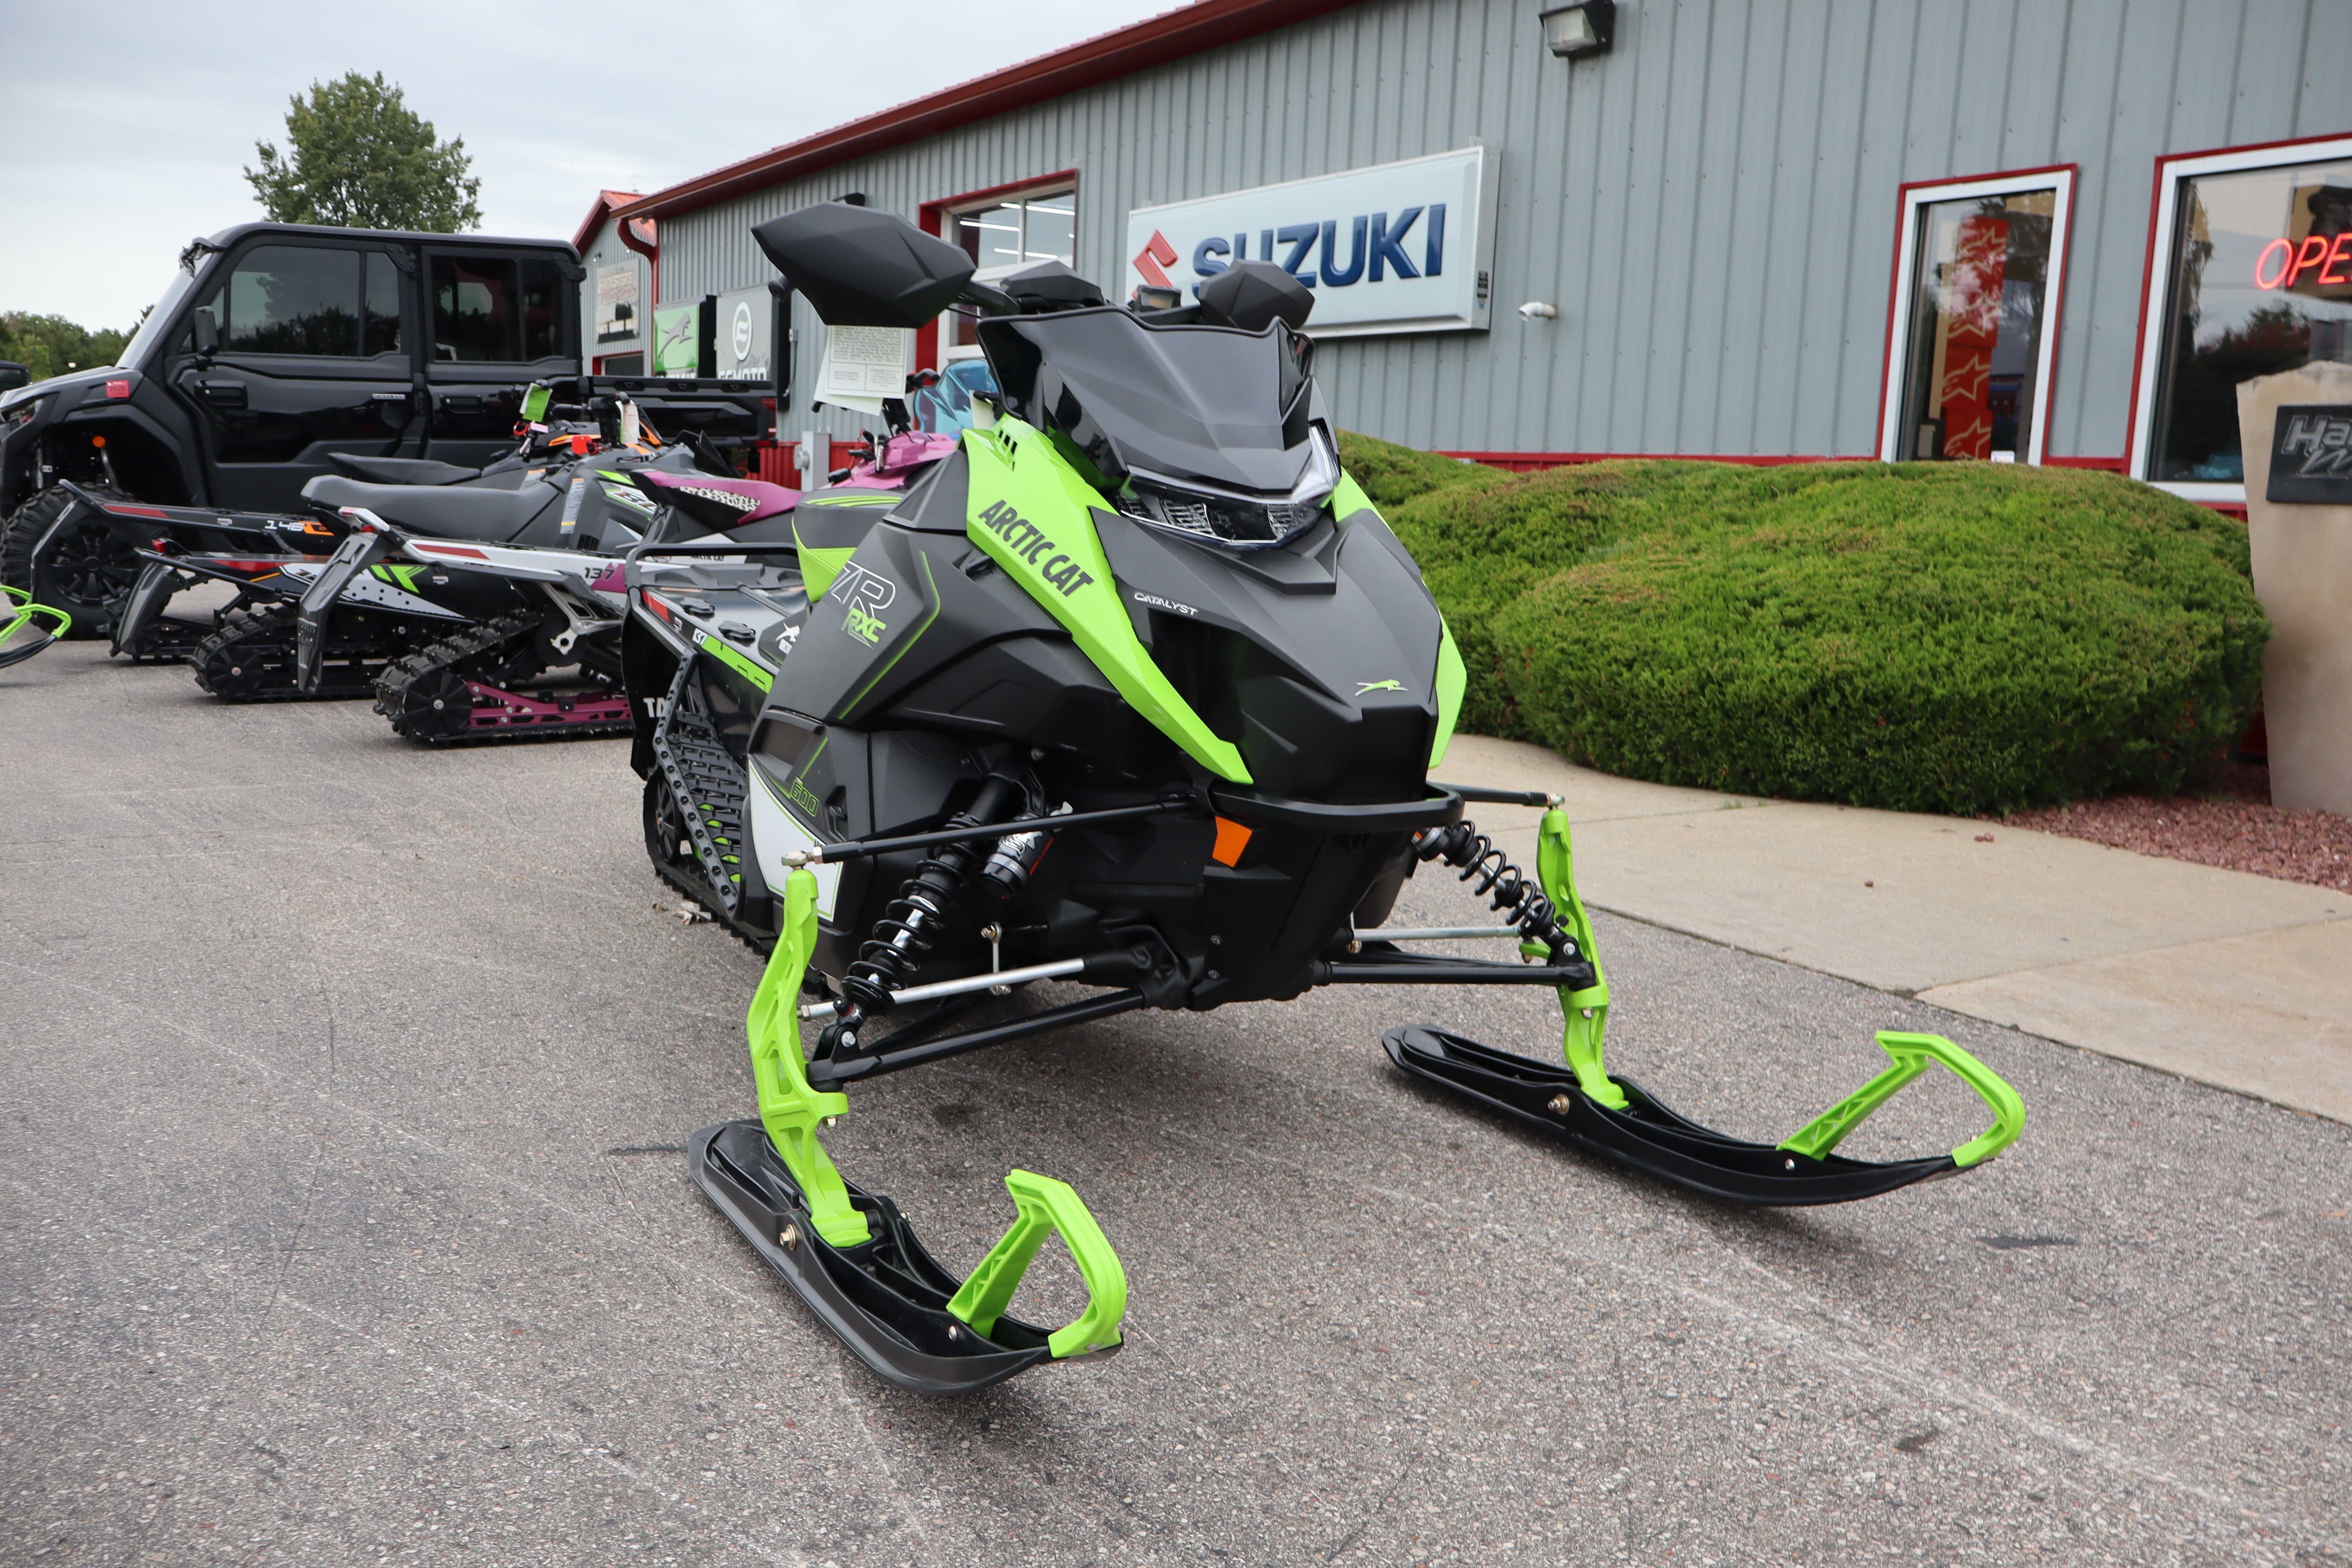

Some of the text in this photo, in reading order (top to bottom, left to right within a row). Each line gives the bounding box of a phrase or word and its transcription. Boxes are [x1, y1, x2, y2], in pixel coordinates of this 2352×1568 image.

[2255, 232, 2352, 290] OPE
[264, 520, 306, 532] 146
[977, 499, 1096, 597] ARCTIC CAT
[584, 566, 615, 580] 137
[1133, 592, 1199, 616] CATALYST
[790, 779, 820, 818] 600
